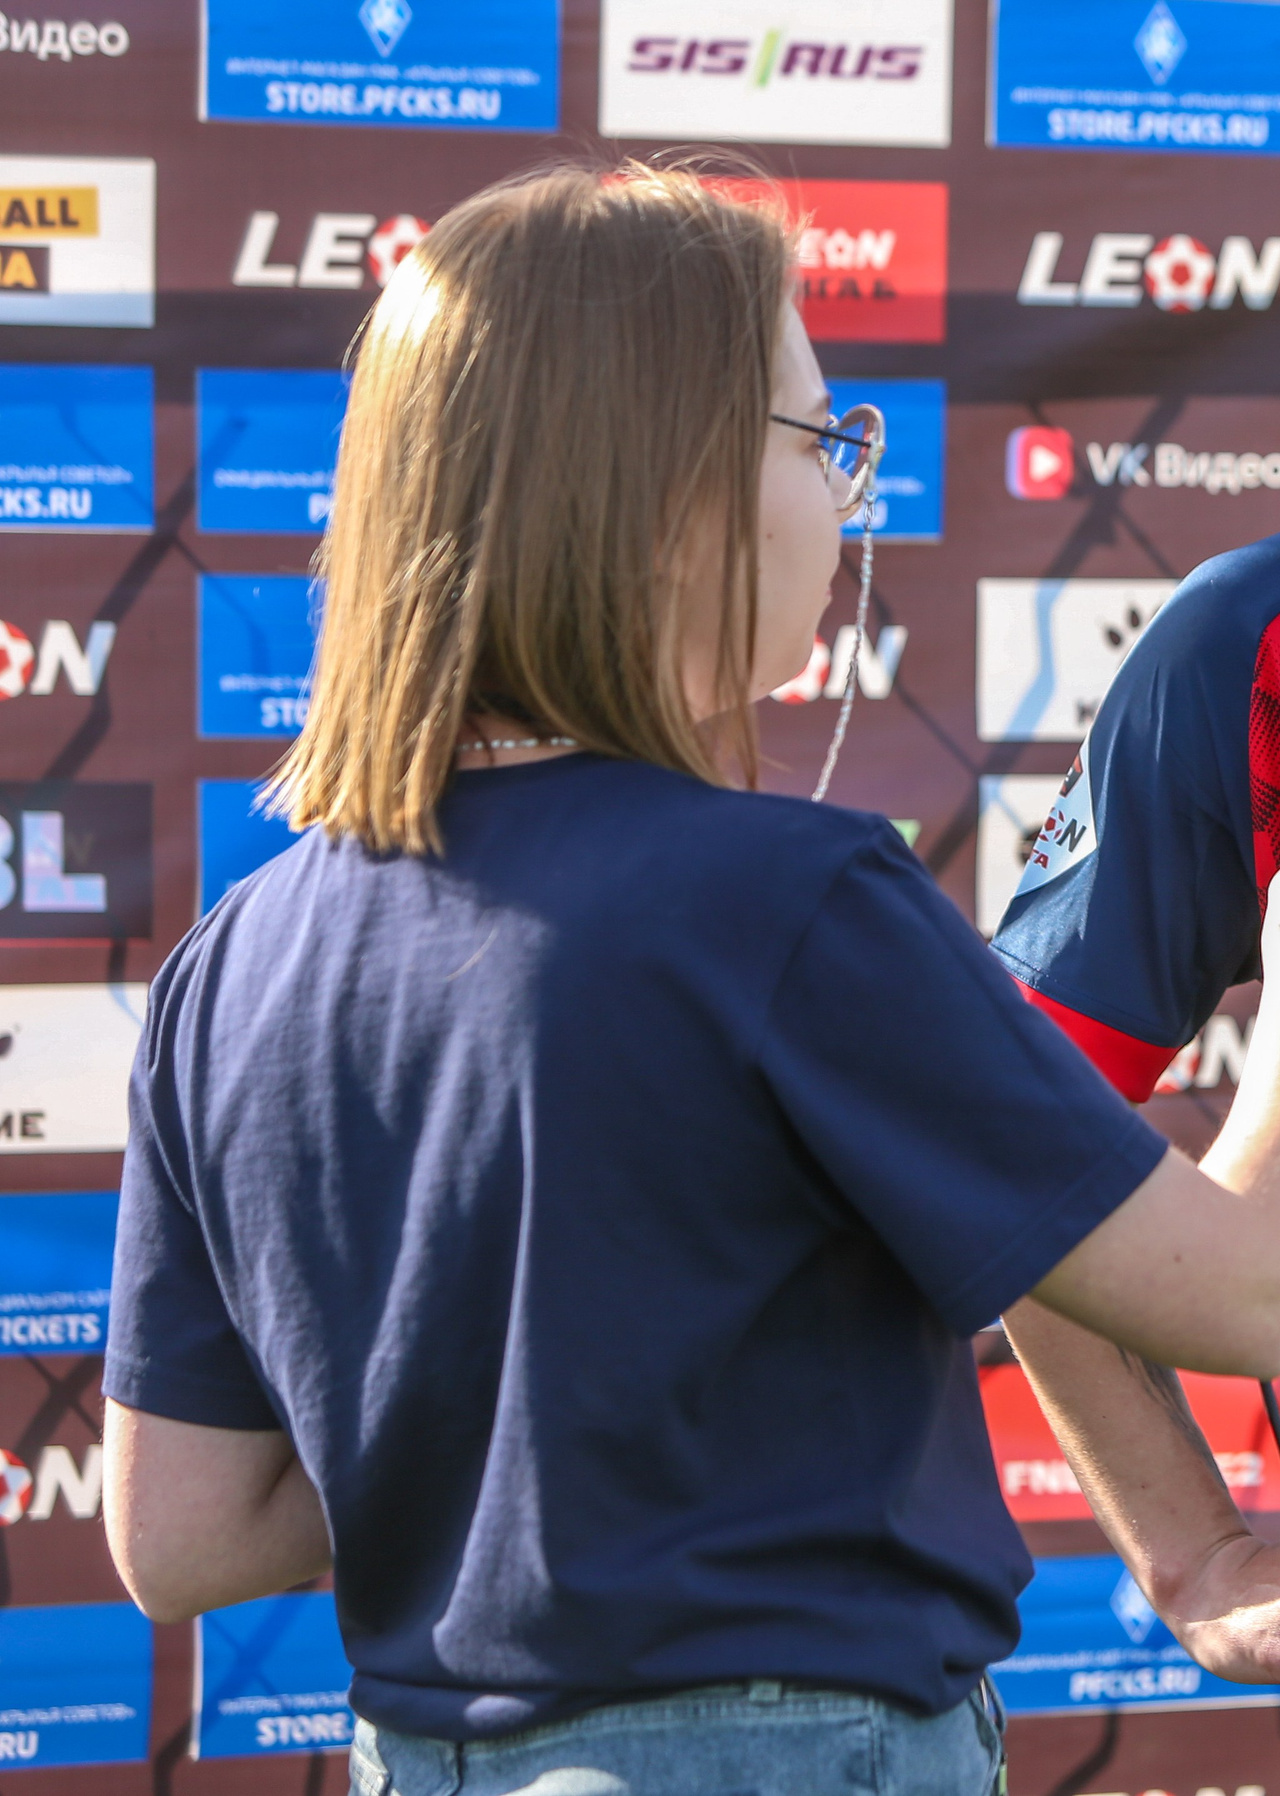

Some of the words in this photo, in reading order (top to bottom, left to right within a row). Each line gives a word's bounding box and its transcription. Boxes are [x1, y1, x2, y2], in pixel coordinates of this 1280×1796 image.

[266, 80, 501, 120] STORE.PFCKS.RU
[1048, 108, 1269, 147] STORE.PFCKS.RU
[798, 227, 898, 271] EON
[1086, 441, 1150, 488] VK
[0, 486, 93, 520] KS.RU
[0, 1313, 101, 1346] ICKETS
[255, 1711, 354, 1748] STORE.
